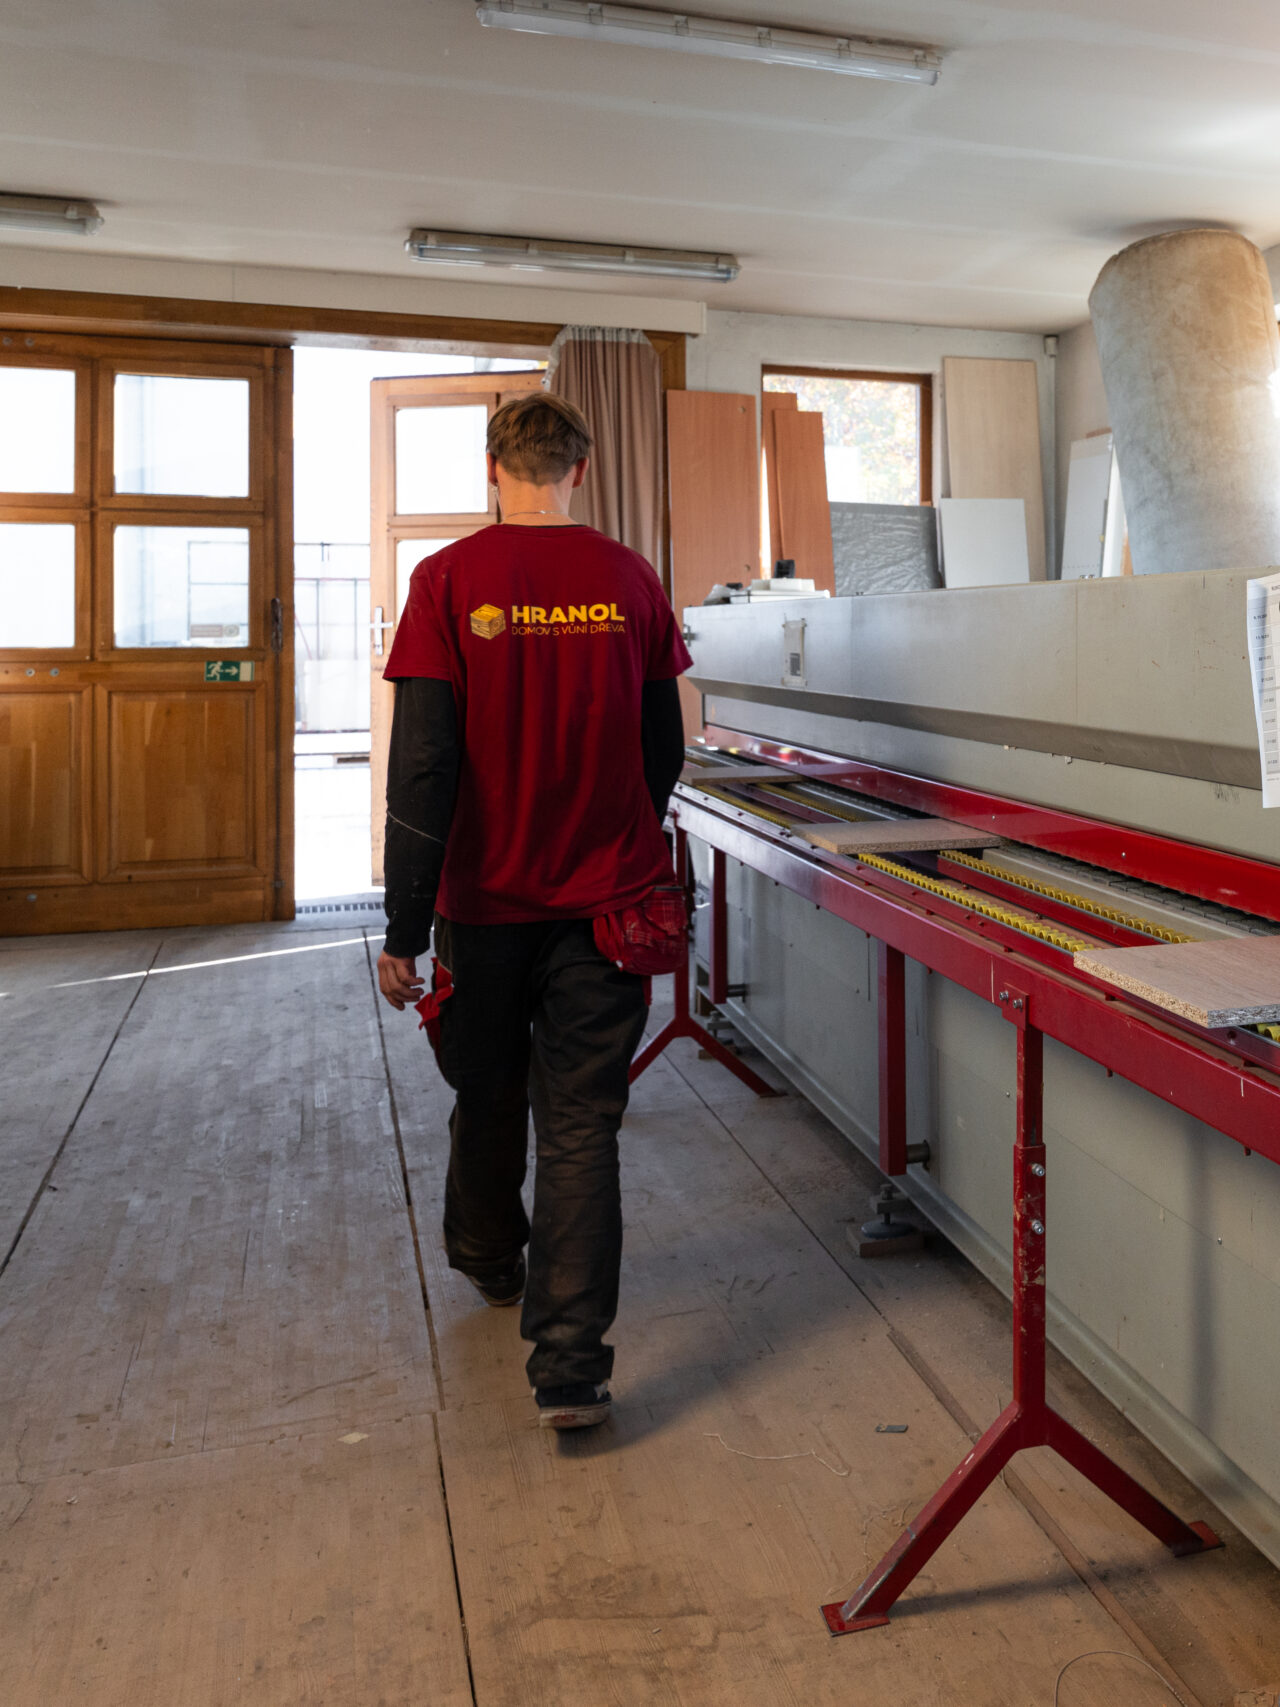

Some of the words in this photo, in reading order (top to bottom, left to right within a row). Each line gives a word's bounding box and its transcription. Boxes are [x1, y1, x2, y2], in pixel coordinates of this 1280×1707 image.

[512, 603, 626, 624] HRANOL
[511, 626, 551, 636] DOMOV
[552, 627, 560, 636] S
[562, 622, 588, 635] VŮNÍ
[590, 622, 625, 634] DŘEVA
